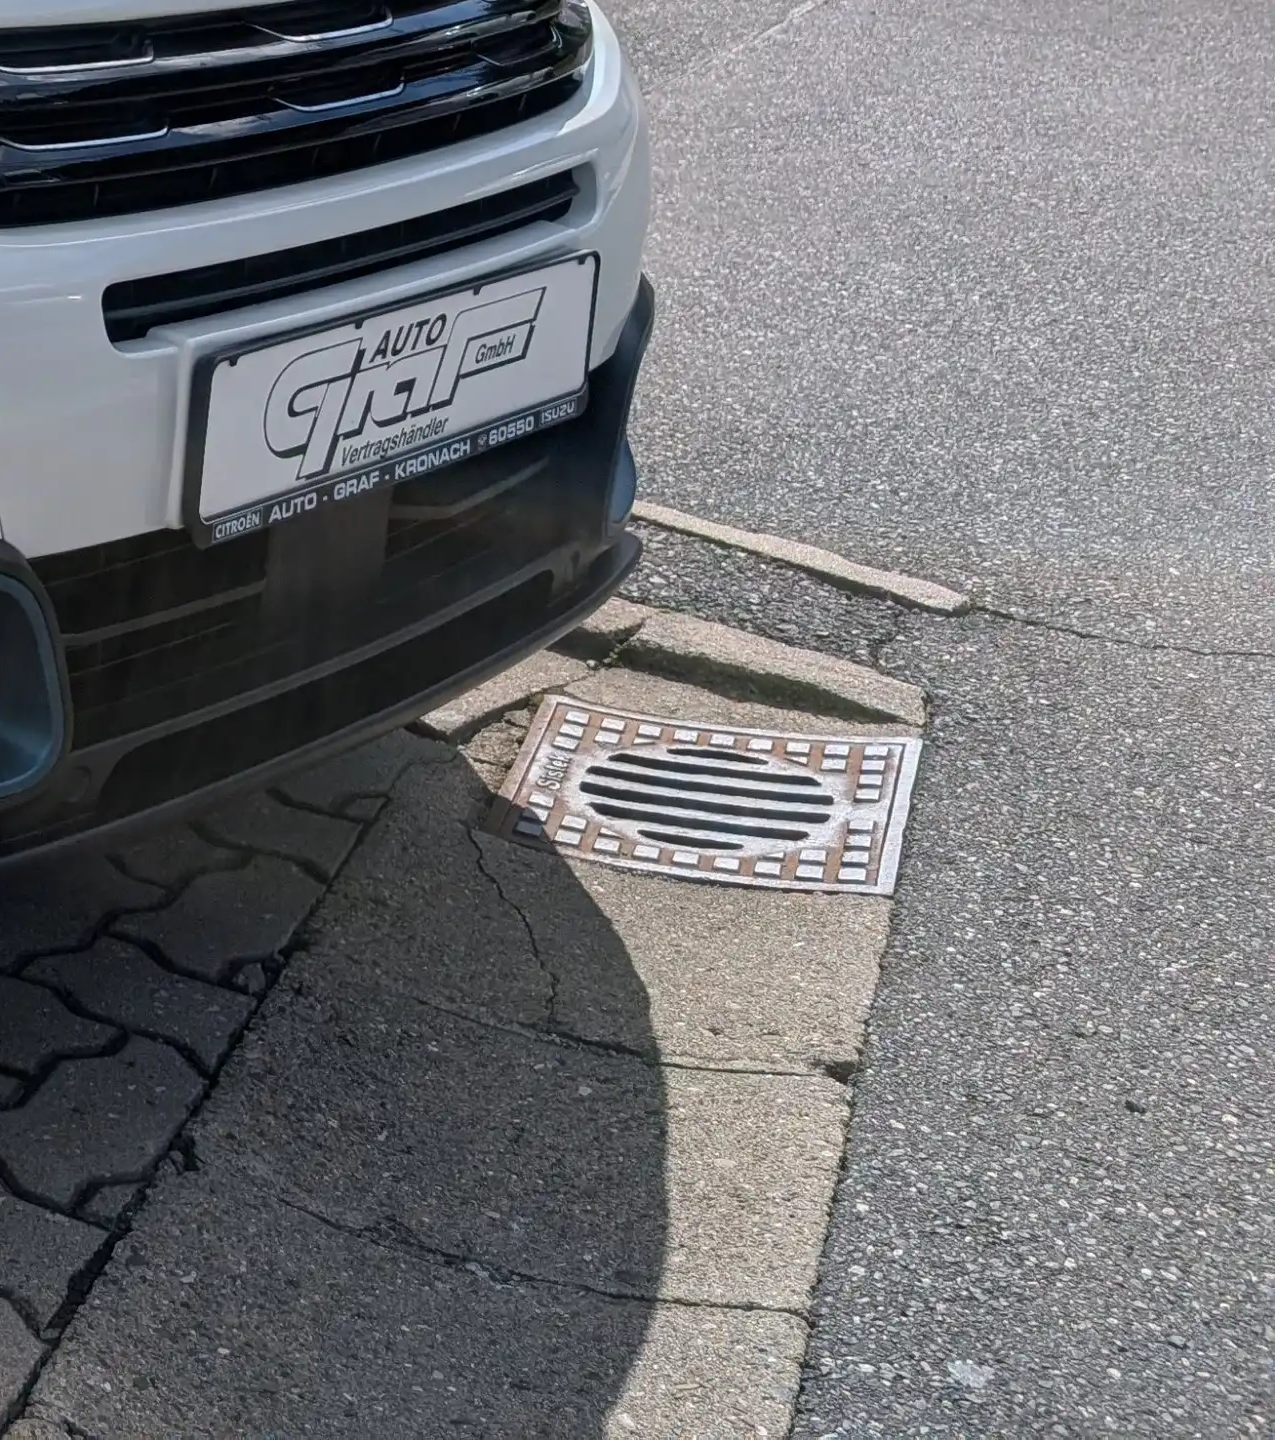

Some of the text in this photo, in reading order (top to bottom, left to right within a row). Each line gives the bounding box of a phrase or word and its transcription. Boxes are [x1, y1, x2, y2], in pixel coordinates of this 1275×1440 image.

[369, 313, 448, 364] AUTO
[474, 333, 516, 364] GmbH
[340, 417, 449, 467] Vertragshändler
[215, 510, 261, 540] CITROËN
[268, 494, 317, 523] AUTO
[333, 471, 380, 500] GRAF
[394, 439, 471, 480] KRONACH
[488, 416, 535, 445] 60550
[541, 400, 576, 424] ISUZU
